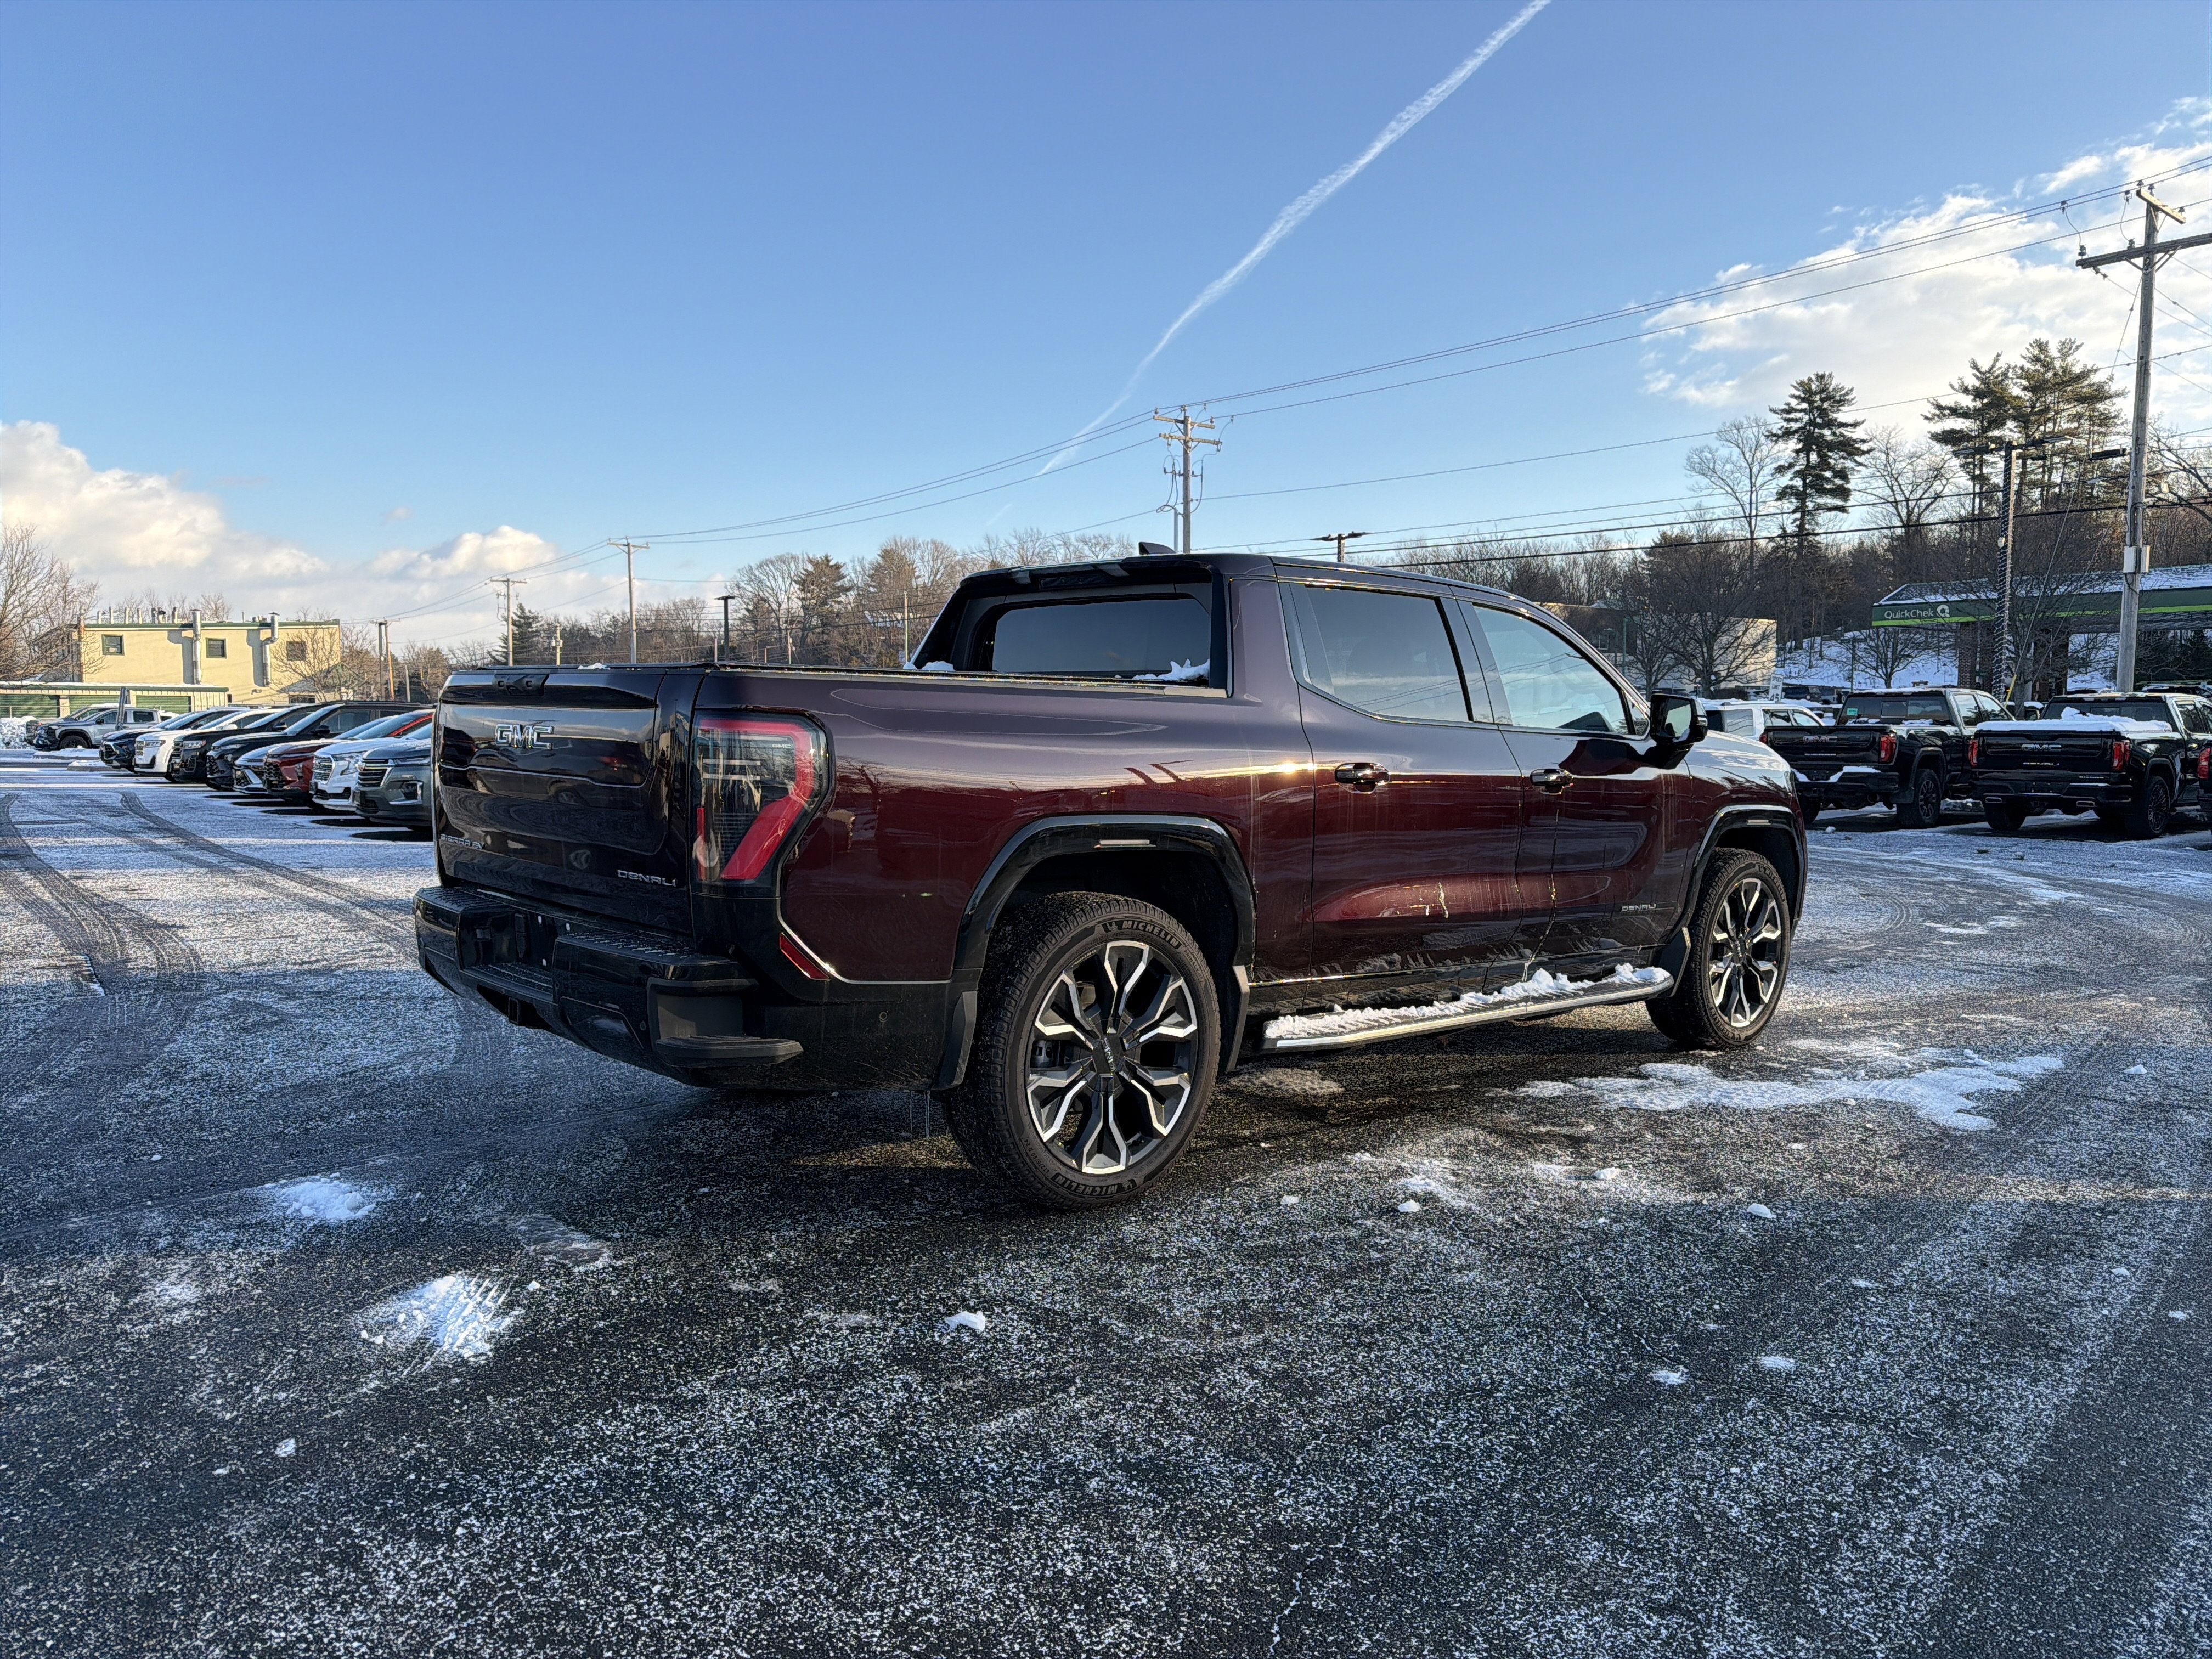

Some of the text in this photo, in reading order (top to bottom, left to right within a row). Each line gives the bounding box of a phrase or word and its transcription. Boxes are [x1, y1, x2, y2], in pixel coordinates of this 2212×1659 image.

[1884, 608, 1934, 620] QuickChek
[495, 724, 554, 750] GMC
[440, 833, 485, 849] SIERRA EV
[617, 870, 676, 887] DENALI
[1121, 921, 1179, 948] MICHELIN
[1183, 950, 1199, 972] PRIMACY
[1055, 1175, 1118, 1195] MICHELIN
